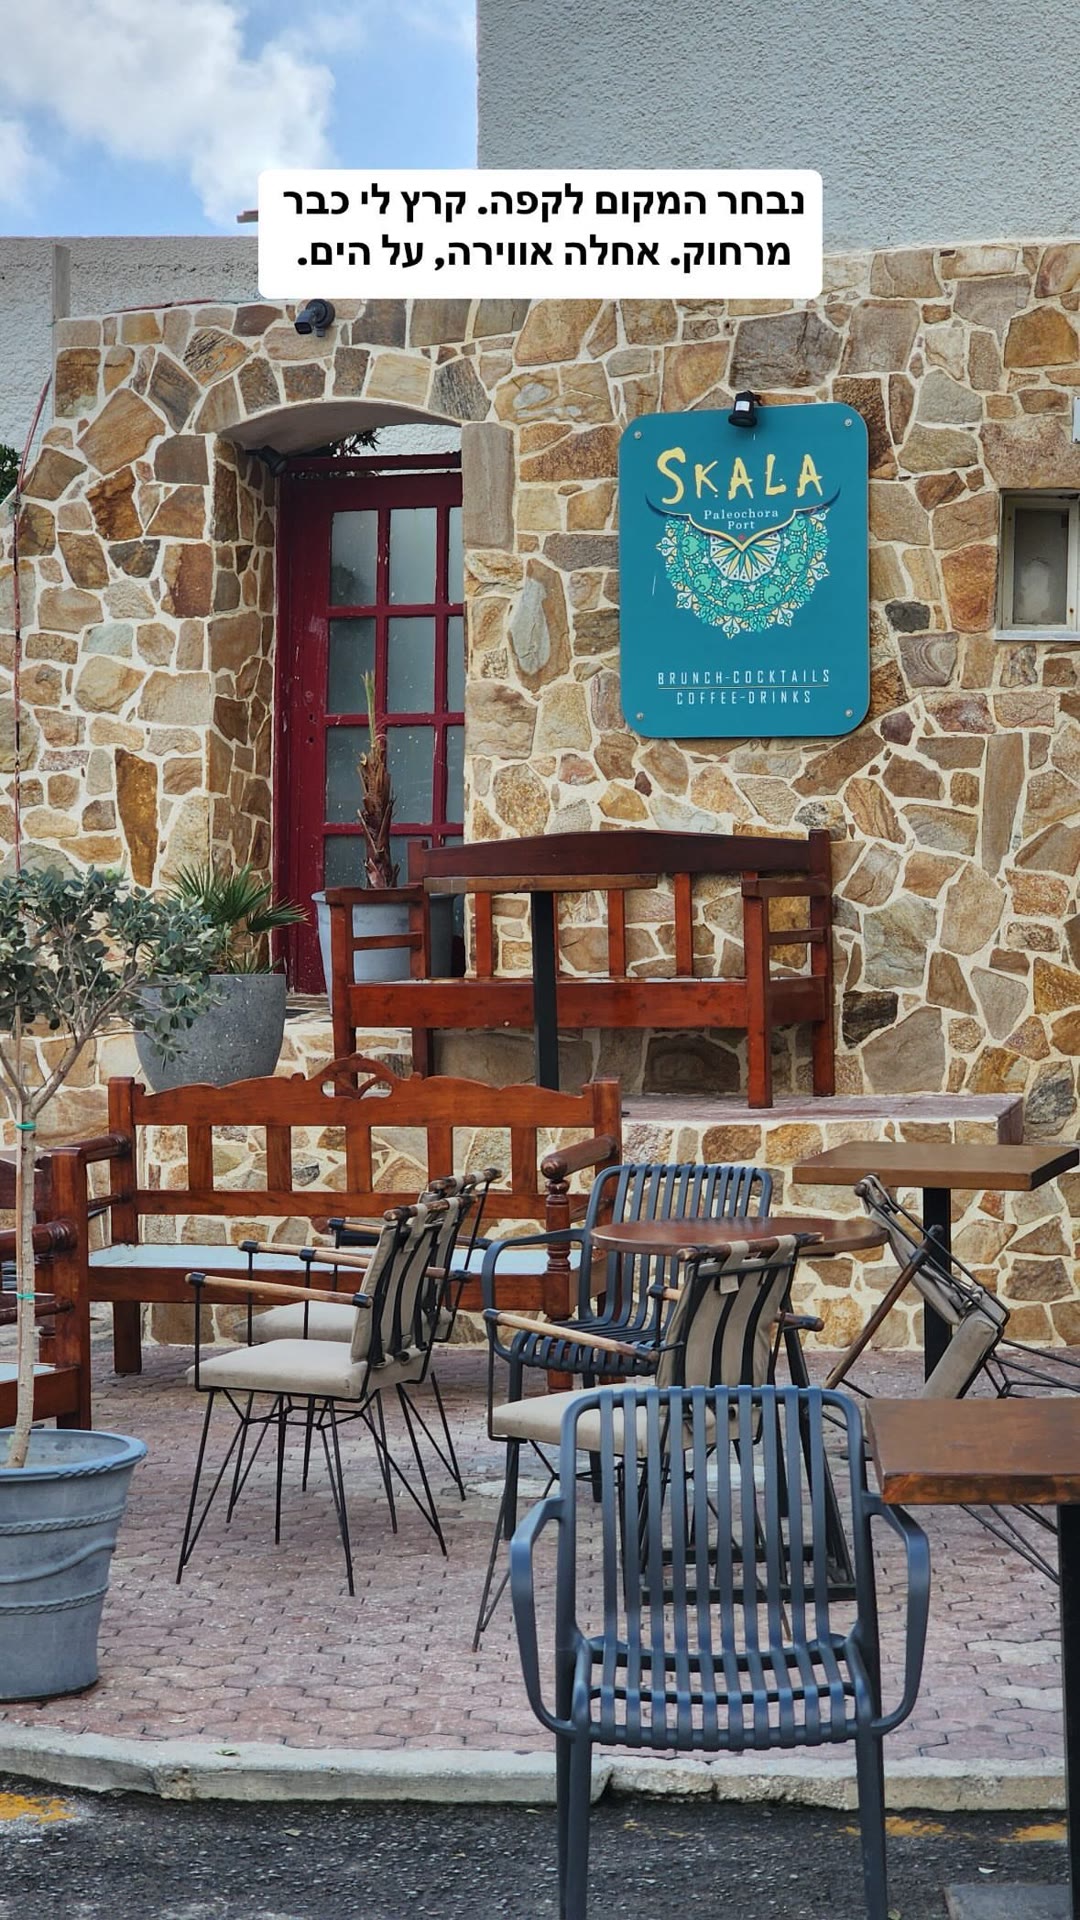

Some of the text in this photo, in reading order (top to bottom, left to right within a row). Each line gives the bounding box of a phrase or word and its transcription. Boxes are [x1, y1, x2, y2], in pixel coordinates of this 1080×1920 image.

[656, 446, 823, 505] SKALA
[703, 508, 779, 520] Paleochora
[727, 520, 756, 531] Port
[657, 669, 831, 685] BRUNCH-COCKTAILS
[676, 690, 812, 705] COFFEE-DRINKS
